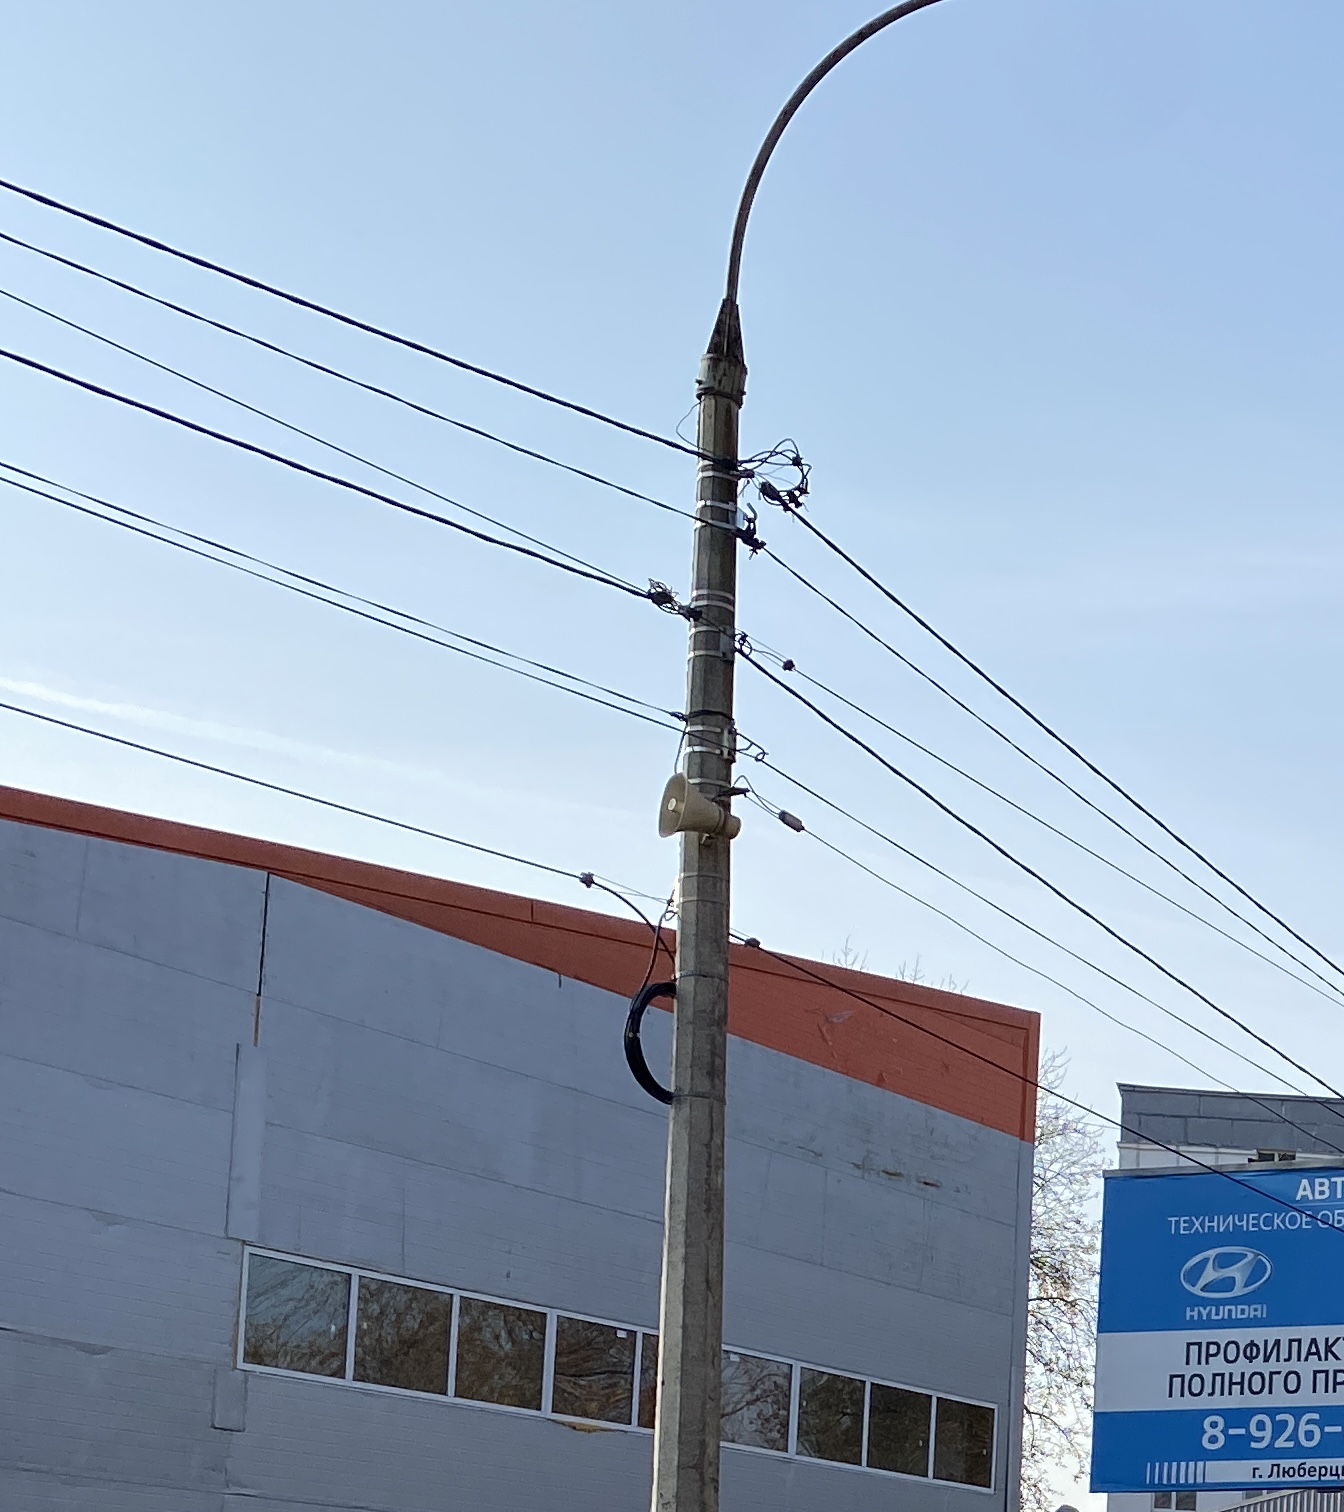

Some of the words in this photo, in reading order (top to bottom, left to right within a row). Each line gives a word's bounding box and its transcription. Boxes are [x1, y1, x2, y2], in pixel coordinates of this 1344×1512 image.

[1168, 1211, 1312, 1235] ТЕХНИЧЕСКОЕ
[1185, 1304, 1267, 1321] HYUNDAI
[1167, 1370, 1302, 1398] ПОЛНОГО
[1252, 1466, 1264, 1479] г.
